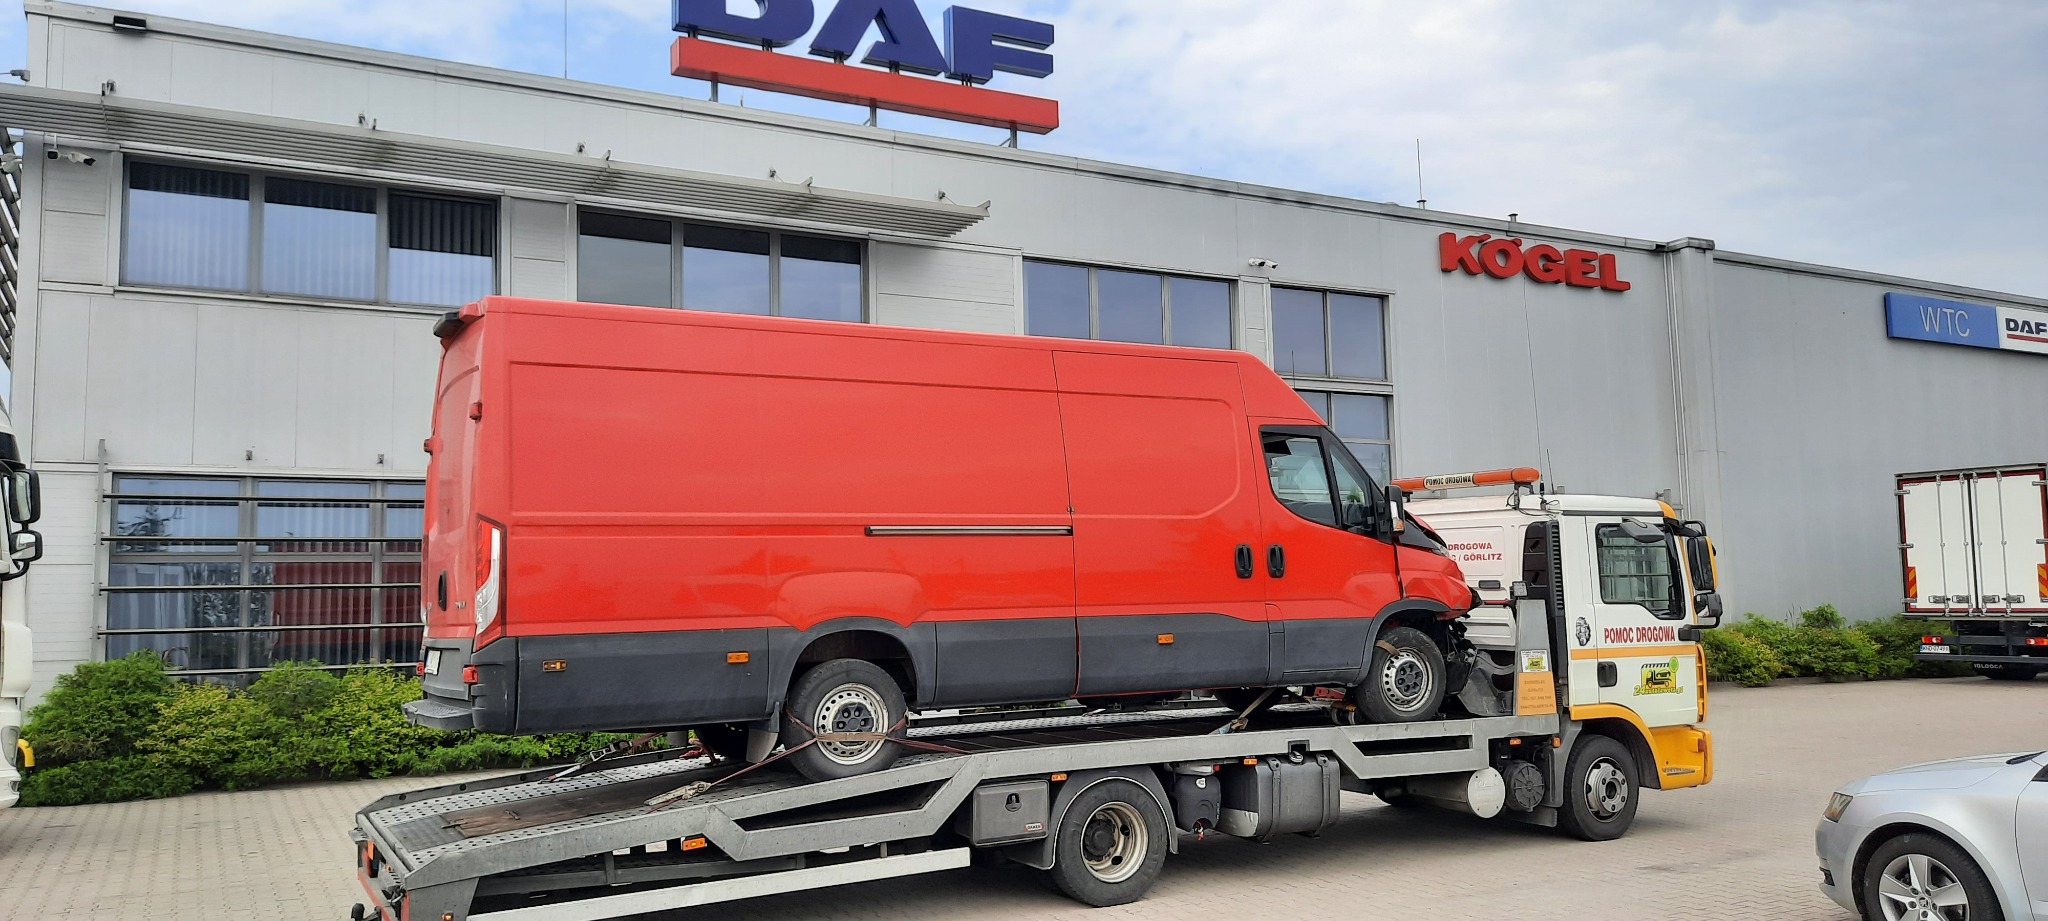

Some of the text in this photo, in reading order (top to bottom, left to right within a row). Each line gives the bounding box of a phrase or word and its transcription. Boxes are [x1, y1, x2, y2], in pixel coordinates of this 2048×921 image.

[1439, 232, 1631, 292] KÖGEL
[1919, 305, 1970, 337] WTC
[2005, 317, 2048, 335] DAF
[1425, 475, 1472, 486] POMOC DROGOWA
[1447, 542, 1493, 551] DROGOWA
[1463, 552, 1502, 561] GÖRLITZ
[1604, 626, 1676, 644] POMOC DROGOWA
